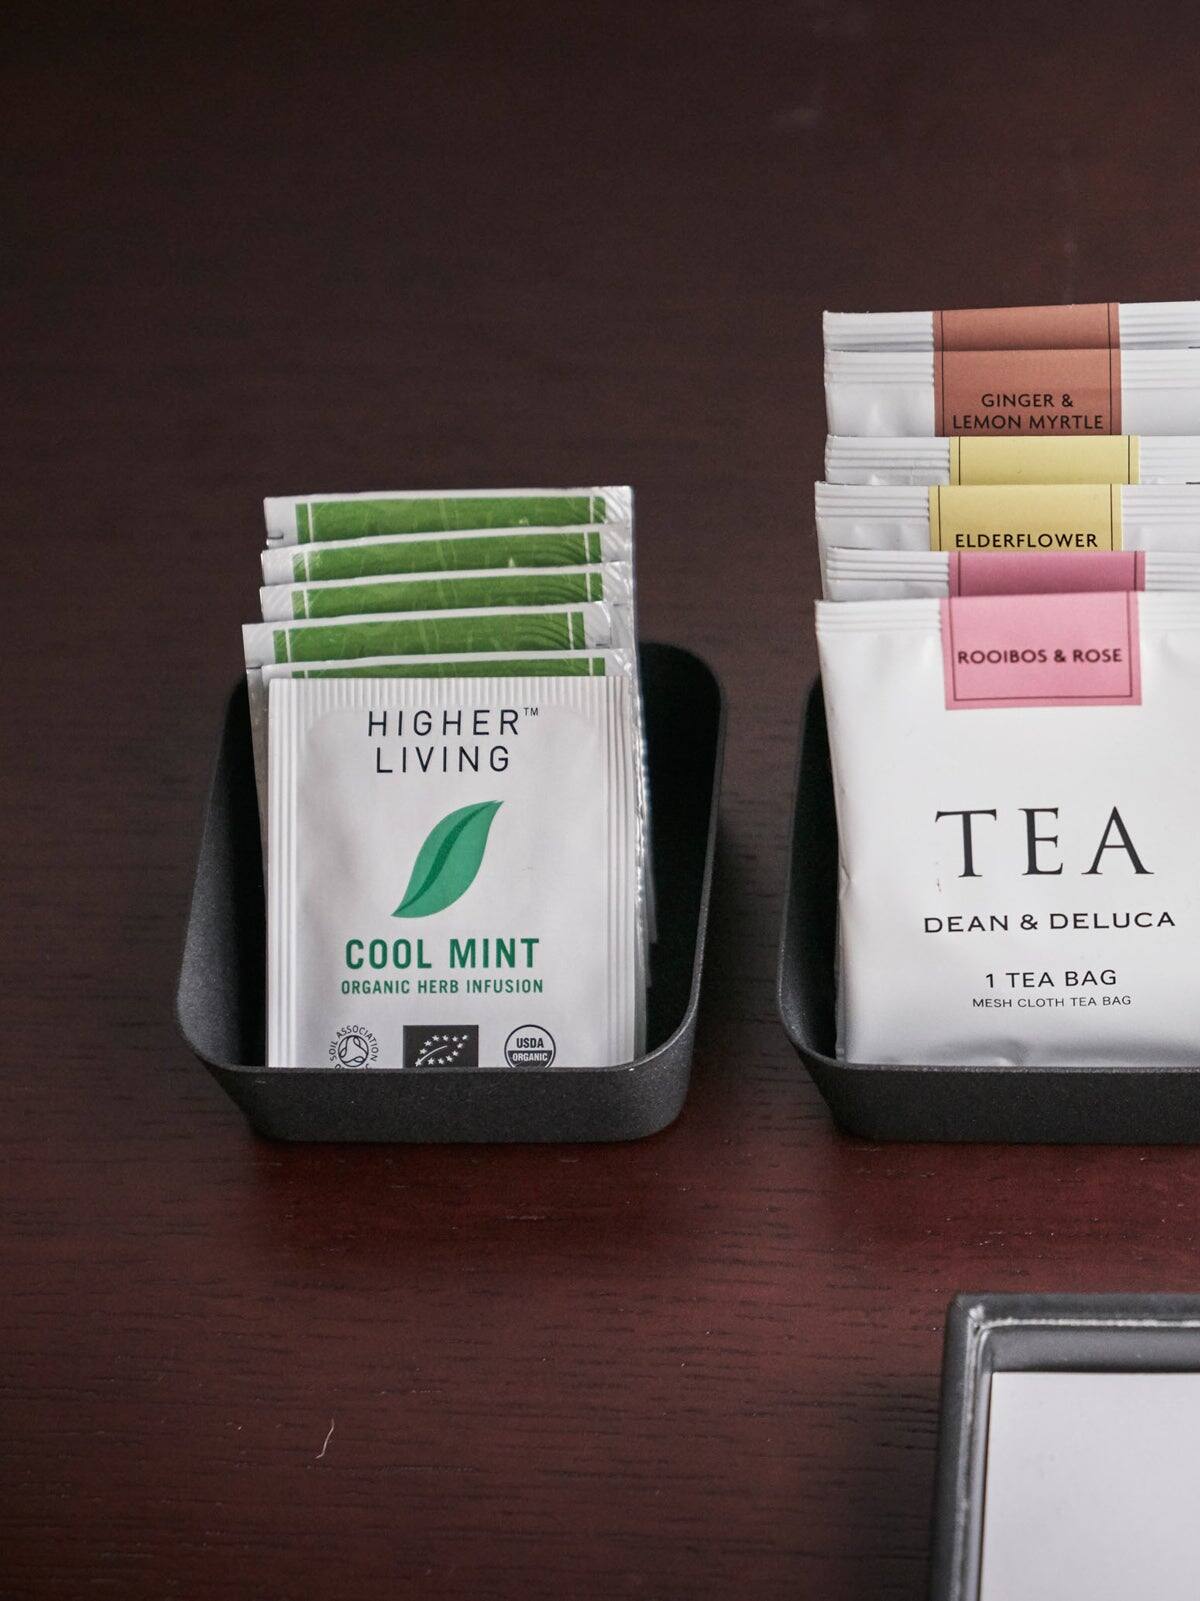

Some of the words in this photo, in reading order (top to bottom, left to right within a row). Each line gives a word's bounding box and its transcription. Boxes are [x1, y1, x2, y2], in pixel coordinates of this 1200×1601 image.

[980, 393, 1055, 408] GINGER
[1061, 393, 1074, 408] &
[952, 414, 1022, 430] LEMON
[1028, 414, 1104, 430] MYRTLE
[955, 533, 1098, 548] ELDERFLOWER
[957, 648, 1048, 665] ROOIBOS
[1053, 648, 1067, 664] &
[1072, 648, 1123, 664] ROSE
[376, 745, 509, 774] LIVING
[934, 805, 1155, 878] TEA
[924, 914, 1009, 934] DEAN
[1020, 913, 1038, 931] &
[1049, 911, 1176, 930] DELUCA
[345, 938, 433, 970] COOL
[449, 937, 540, 969] MINT
[340, 979, 410, 995] ORGANIC
[417, 979, 459, 994] HERB
[466, 978, 543, 994] INFUSION
[985, 973, 994, 989] 1
[1005, 971, 1055, 989] TEA
[1064, 969, 1117, 987] BAG
[972, 998, 1013, 1008] MESH
[1017, 997, 1065, 1008] CLOTH
[1069, 996, 1098, 1007] TEA
[1102, 995, 1132, 1006] BAG
[328, 1041, 338, 1061] SOIL
[336, 1025, 379, 1062] ASSOCIATION
[516, 1037, 545, 1049] USDA
[512, 1052, 548, 1062] ORGANIC
